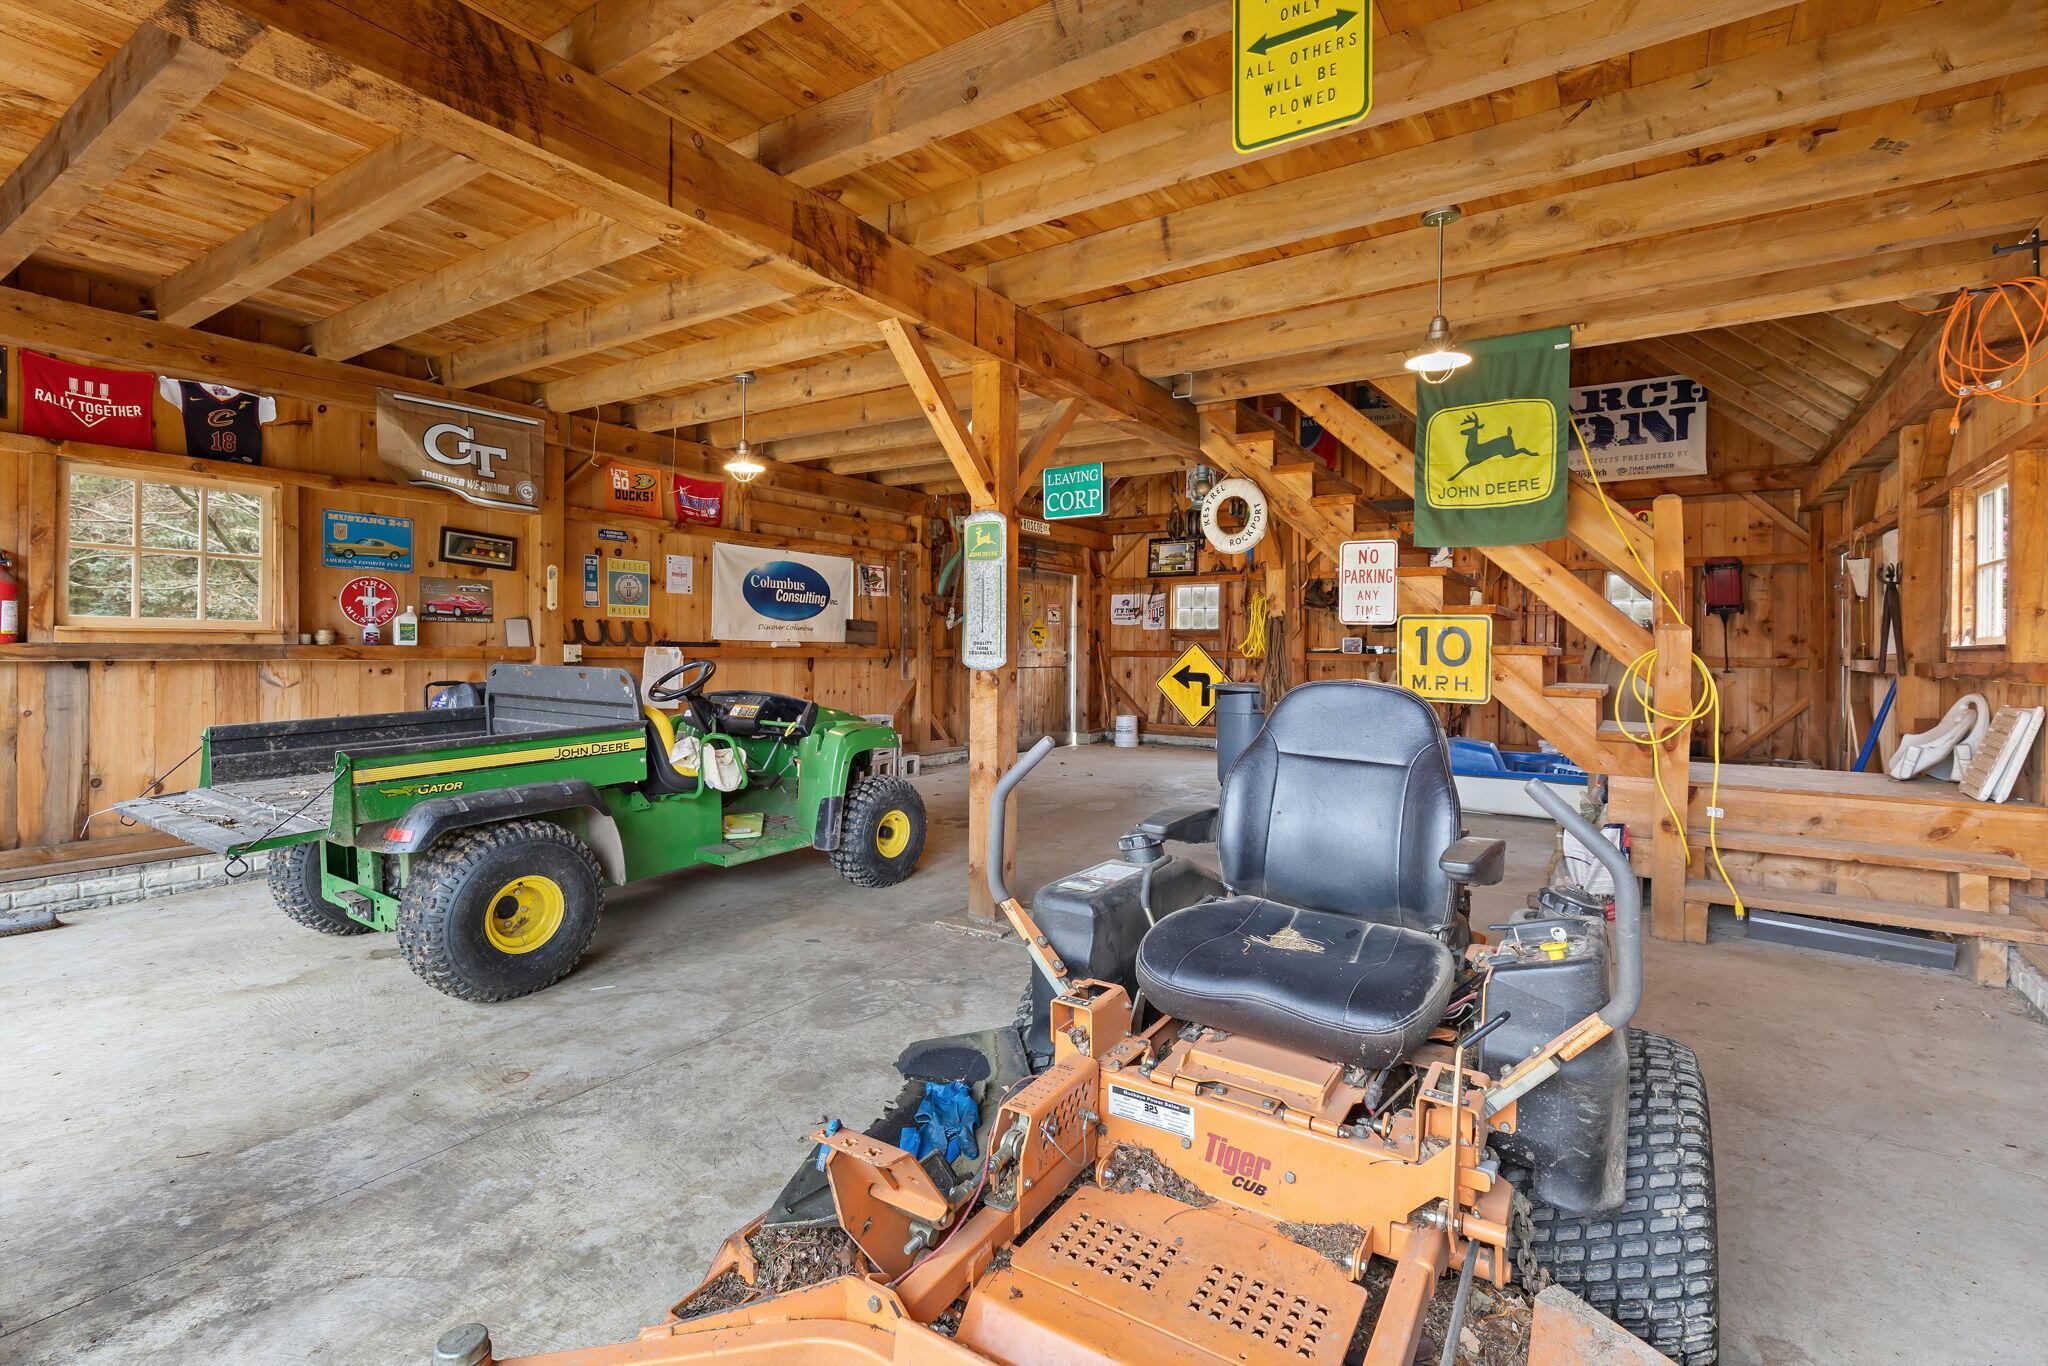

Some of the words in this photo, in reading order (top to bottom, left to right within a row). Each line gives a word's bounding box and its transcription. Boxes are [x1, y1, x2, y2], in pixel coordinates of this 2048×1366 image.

[1280, 0, 1322, 21] ONLY
[1246, 61, 1275, 80] ALL
[1290, 32, 1358, 65] OTHERS
[1264, 75, 1303, 96] WILL
[1317, 63, 1338, 80] BE
[1269, 88, 1337, 118] PLOWED
[34, 388, 74, 410] RALLY
[80, 400, 142, 418] TOGETHER
[207, 409, 237, 428] C
[210, 431, 237, 453] 18
[423, 422, 508, 479] GT
[1577, 456, 1620, 466] PLYOFFS
[1622, 451, 1674, 462] PRESENTED
[1677, 450, 1689, 458] BY
[1646, 463, 1675, 471] WARNER
[420, 469, 465, 488] TOGETHER
[466, 479, 481, 490] WE
[610, 468, 629, 478] LET'S
[1047, 468, 1100, 487] LEAVING
[612, 477, 630, 490] GO
[1438, 485, 1480, 499] JOHN
[1485, 477, 1541, 496] DEERE
[615, 489, 654, 502] DUCKS!
[1046, 488, 1100, 512] CORP
[1202, 484, 1226, 527] KESTREL
[327, 513, 386, 526] MUSTANG
[388, 518, 410, 528] 2+2
[1229, 503, 1263, 547] ROCKPORT
[1358, 549, 1379, 564] NO
[750, 574, 806, 591] Columbus
[1344, 568, 1393, 584] PARKING
[351, 580, 388, 592] FORD
[1357, 590, 1380, 600] ANY
[775, 588, 827, 607] Consulting
[345, 605, 396, 624] MUSNG
[1354, 605, 1381, 616] TIME
[757, 623, 785, 631] Discover
[785, 623, 814, 632] Columbus
[1415, 626, 1472, 668] 10
[554, 746, 589, 760] JOHN
[591, 742, 631, 755] DEERE
[416, 781, 464, 796] GATOR
[1123, 1089, 1147, 1102] Buckeye
[1146, 1095, 1164, 1106] Power
[1163, 1101, 1180, 1111] Sales
[1204, 1132, 1272, 1181] Tiger
[1231, 1176, 1269, 1197] CUB
